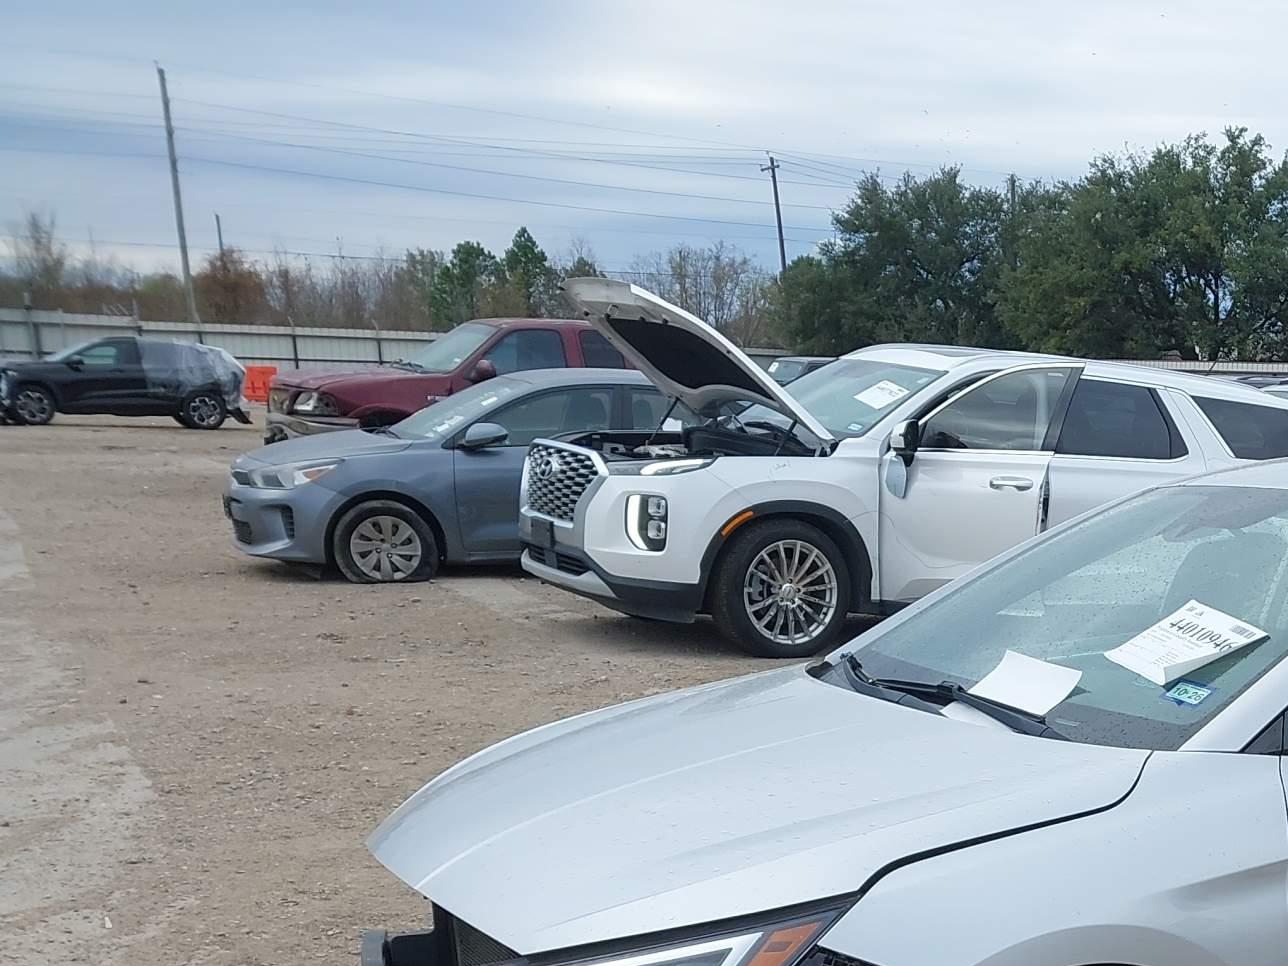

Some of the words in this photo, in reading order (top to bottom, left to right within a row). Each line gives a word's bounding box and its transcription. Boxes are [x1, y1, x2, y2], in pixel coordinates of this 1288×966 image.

[1169, 618, 1238, 653] 44010946
[1173, 687, 1186, 697] 10
[1187, 690, 1205, 702] 26
